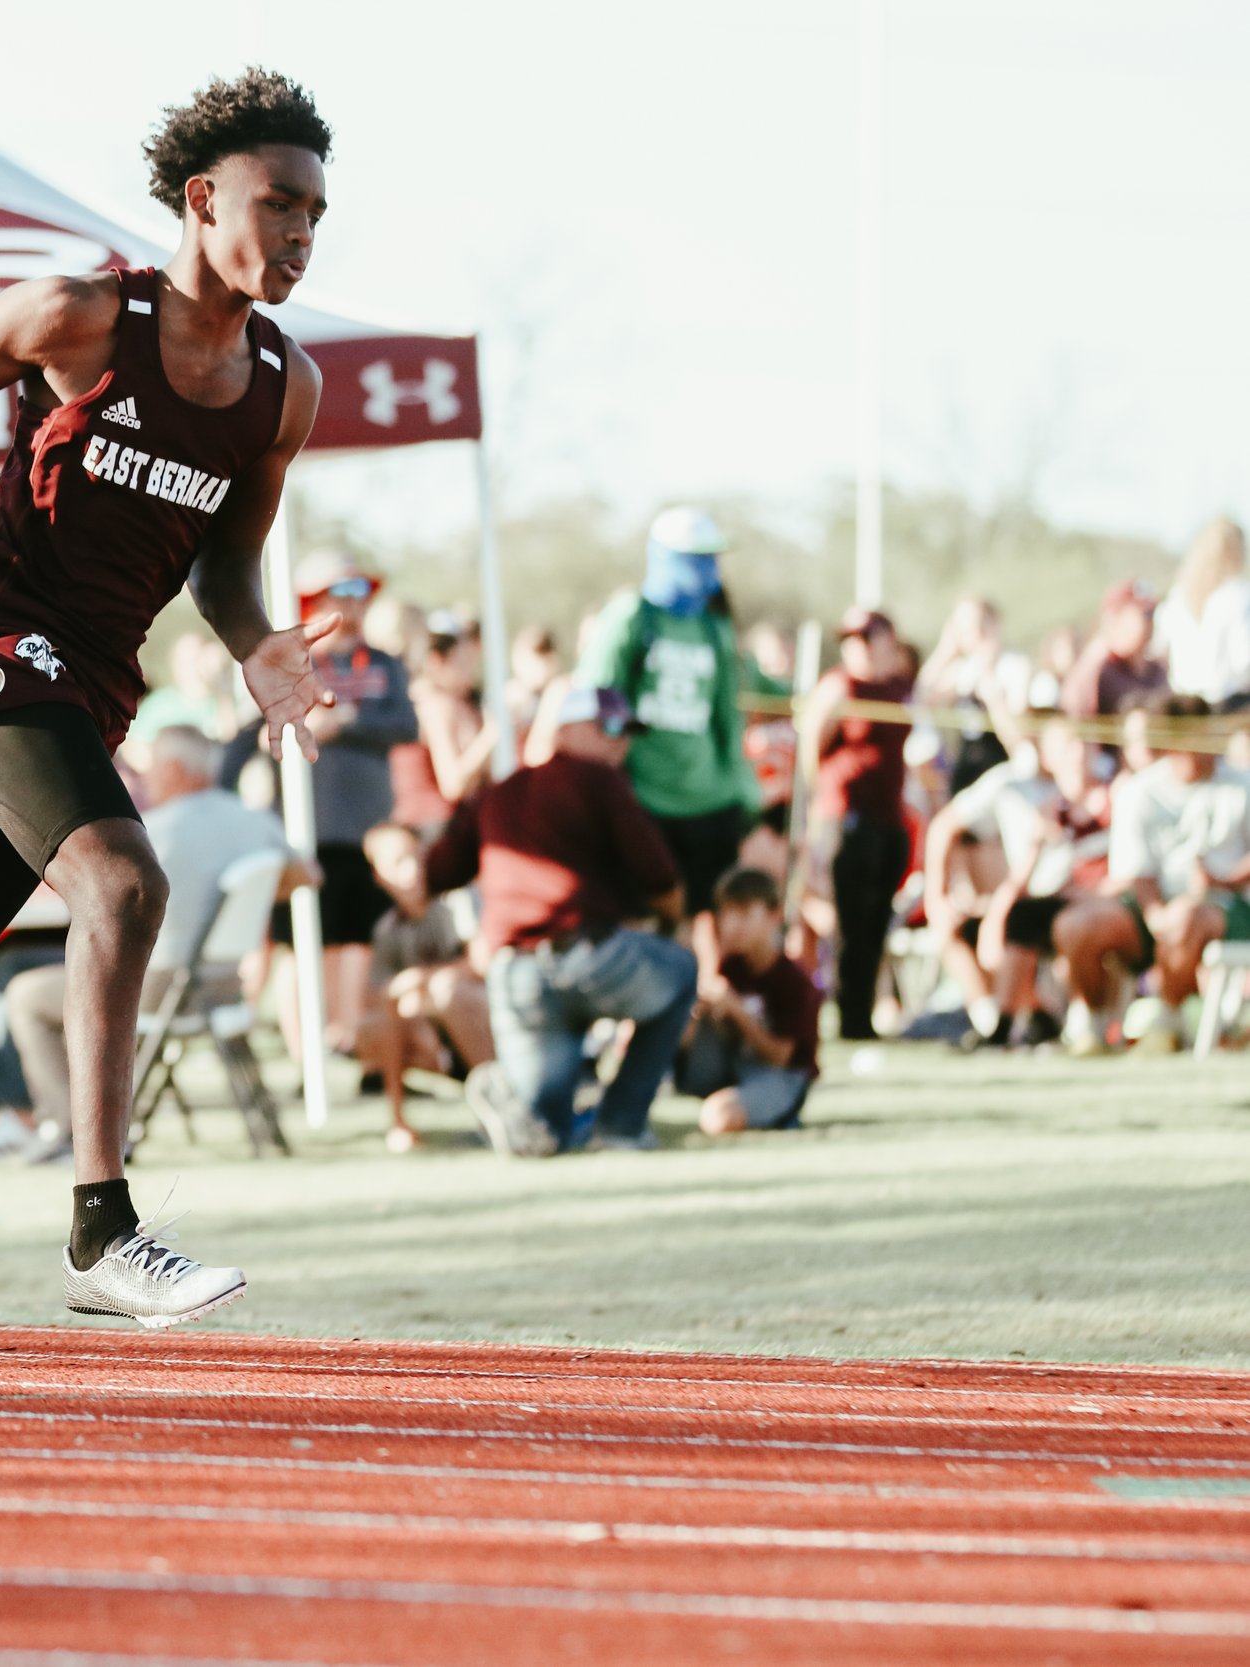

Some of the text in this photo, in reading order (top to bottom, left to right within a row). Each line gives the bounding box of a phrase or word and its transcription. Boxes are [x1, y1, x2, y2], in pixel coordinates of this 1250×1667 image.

[101, 410, 141, 430] adidas
[82, 434, 151, 490] EAST
[85, 1196, 102, 1208] ck
